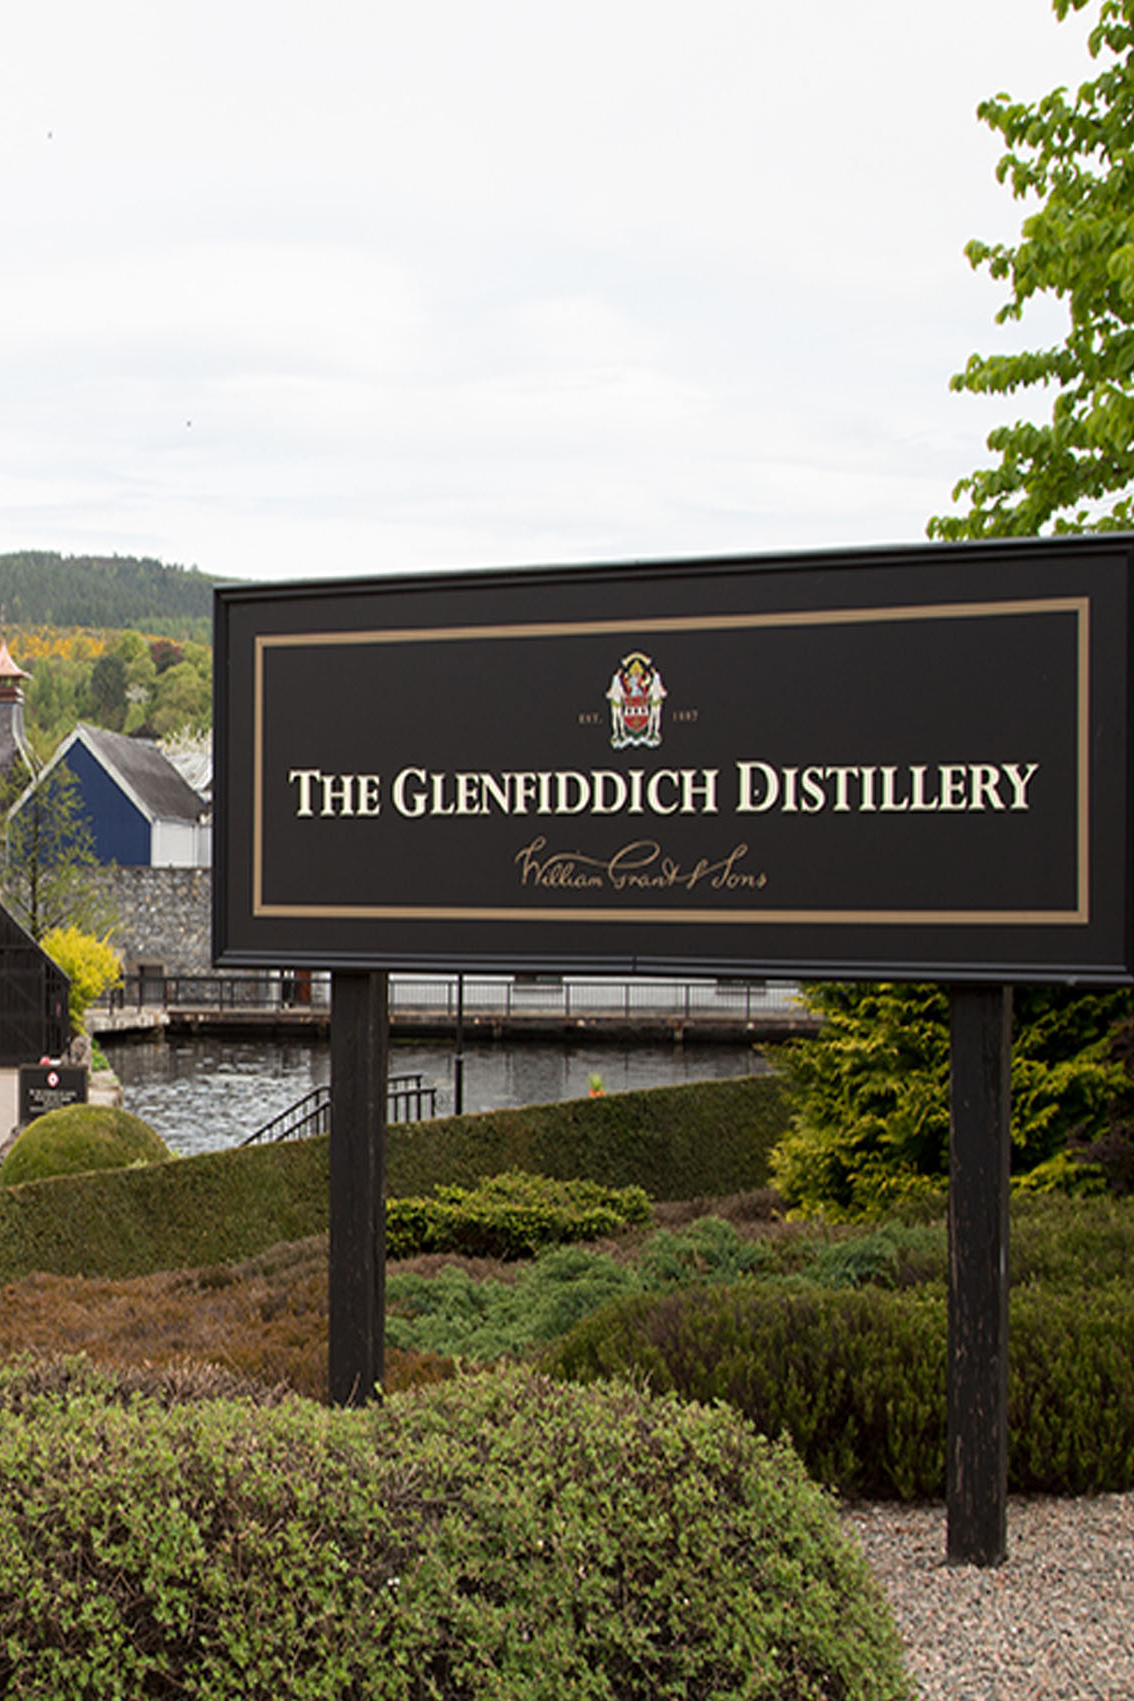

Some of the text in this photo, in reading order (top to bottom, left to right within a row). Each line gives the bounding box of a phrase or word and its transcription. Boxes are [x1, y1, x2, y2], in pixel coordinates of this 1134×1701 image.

[290, 760, 1039, 818] THE GLENFIDDICH DISTILLERY
[514, 836, 604, 888] William
[608, 840, 677, 889] Grant
[711, 843, 768, 889] Sons
